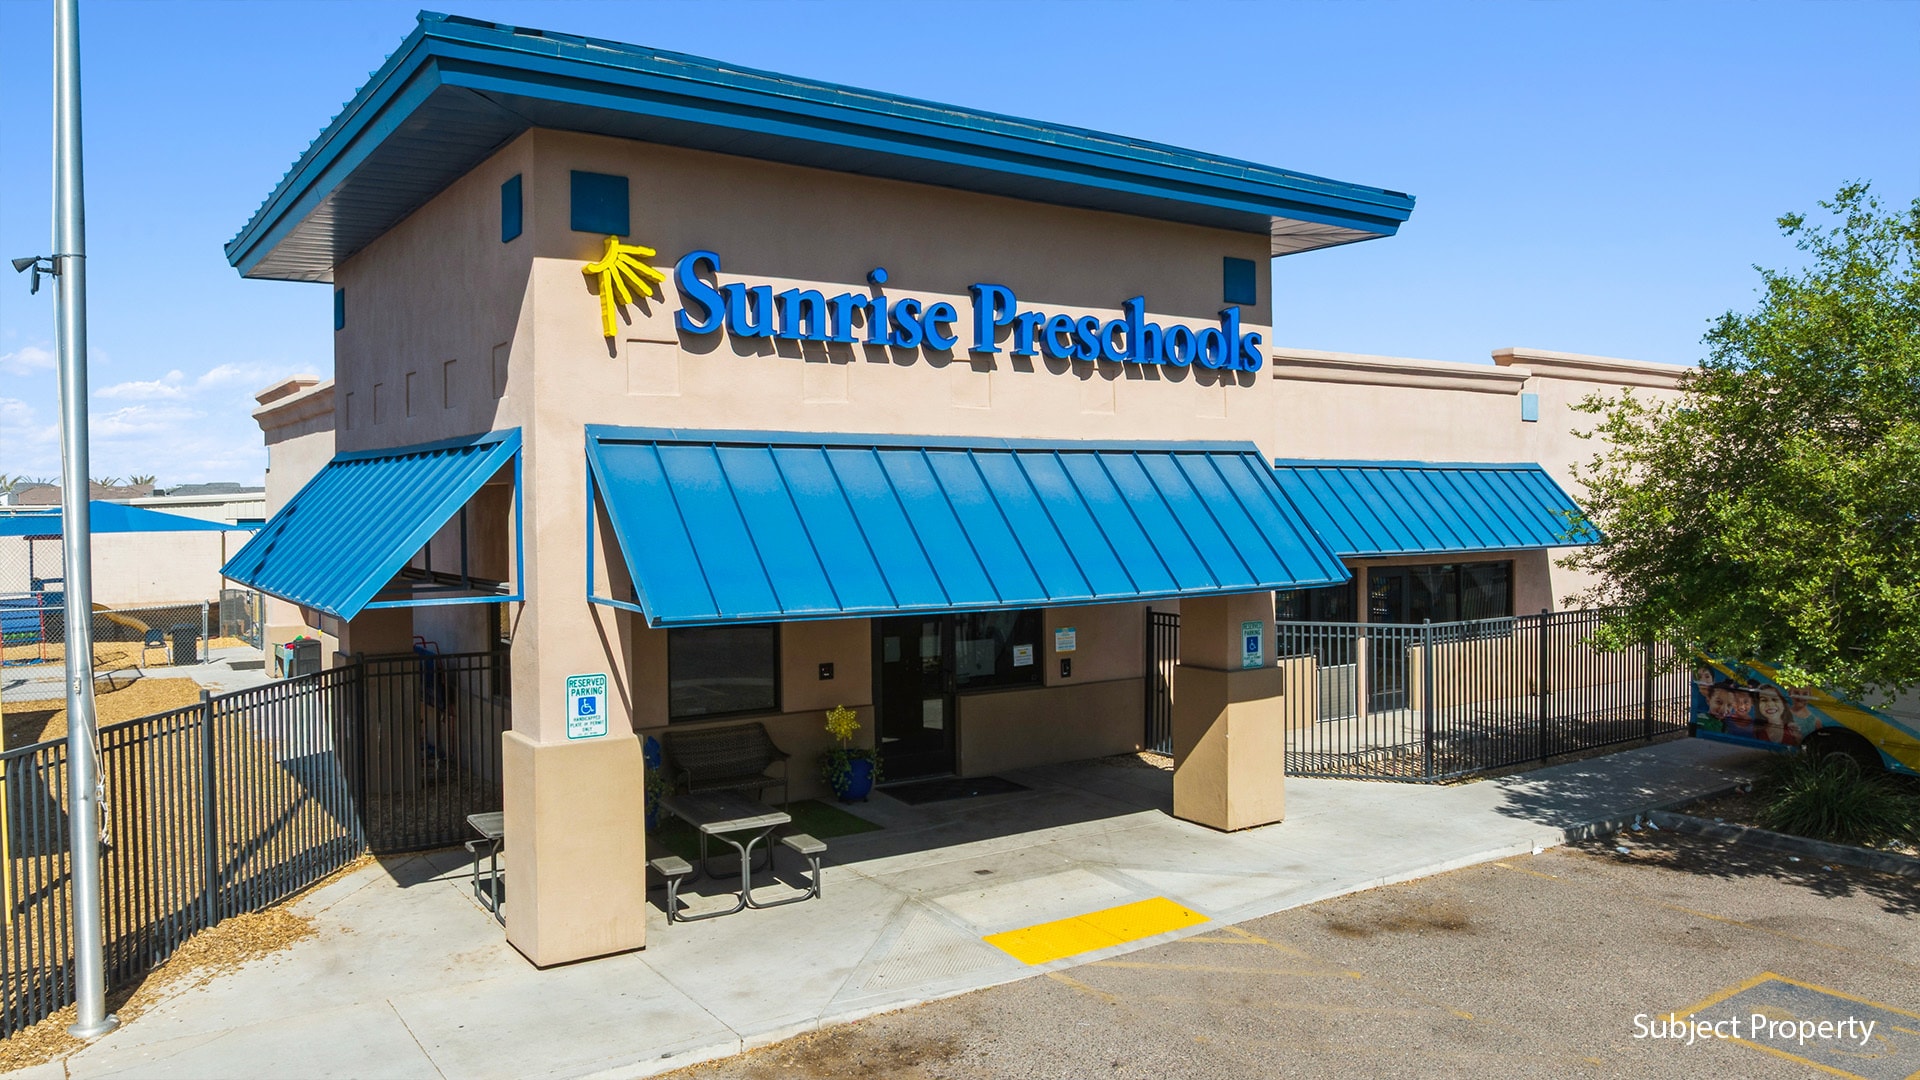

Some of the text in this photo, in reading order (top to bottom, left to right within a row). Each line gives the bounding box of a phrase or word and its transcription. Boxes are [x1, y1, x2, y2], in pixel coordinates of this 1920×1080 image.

[673, 249, 1264, 374] Sunrise Preschools
[568, 677, 605, 688] RESERVED
[571, 687, 603, 696] PARKING
